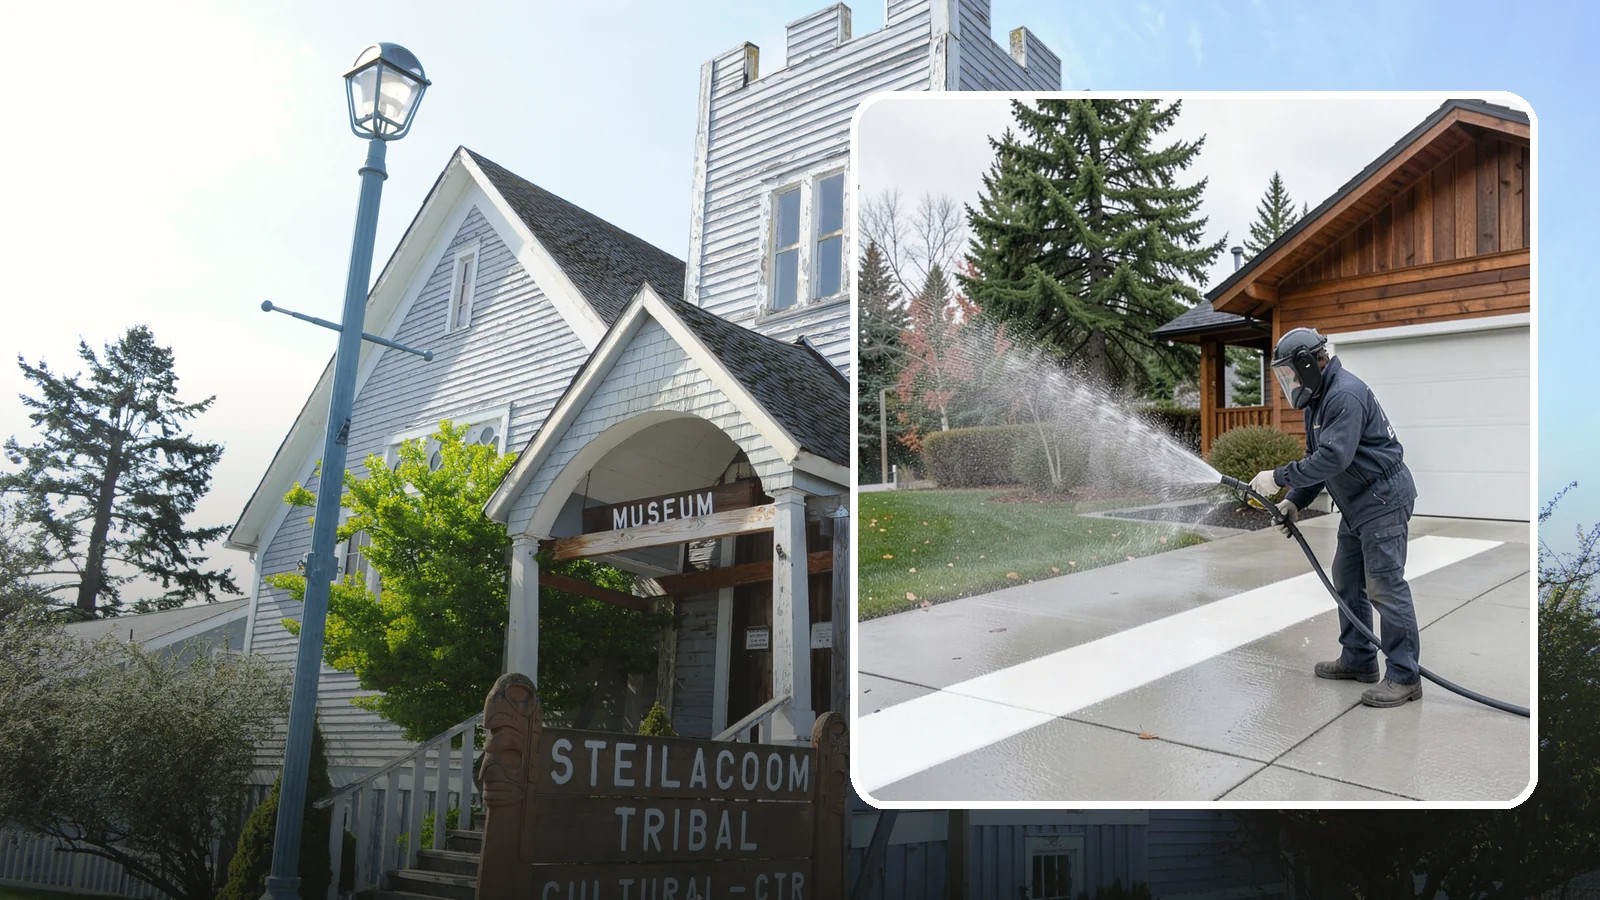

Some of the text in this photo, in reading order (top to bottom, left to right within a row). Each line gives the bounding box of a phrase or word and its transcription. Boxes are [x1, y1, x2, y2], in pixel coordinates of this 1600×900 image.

[613, 491, 713, 531] MUSEUM
[550, 738, 809, 793] STEILACOOM
[615, 806, 758, 853] TRIBAL
